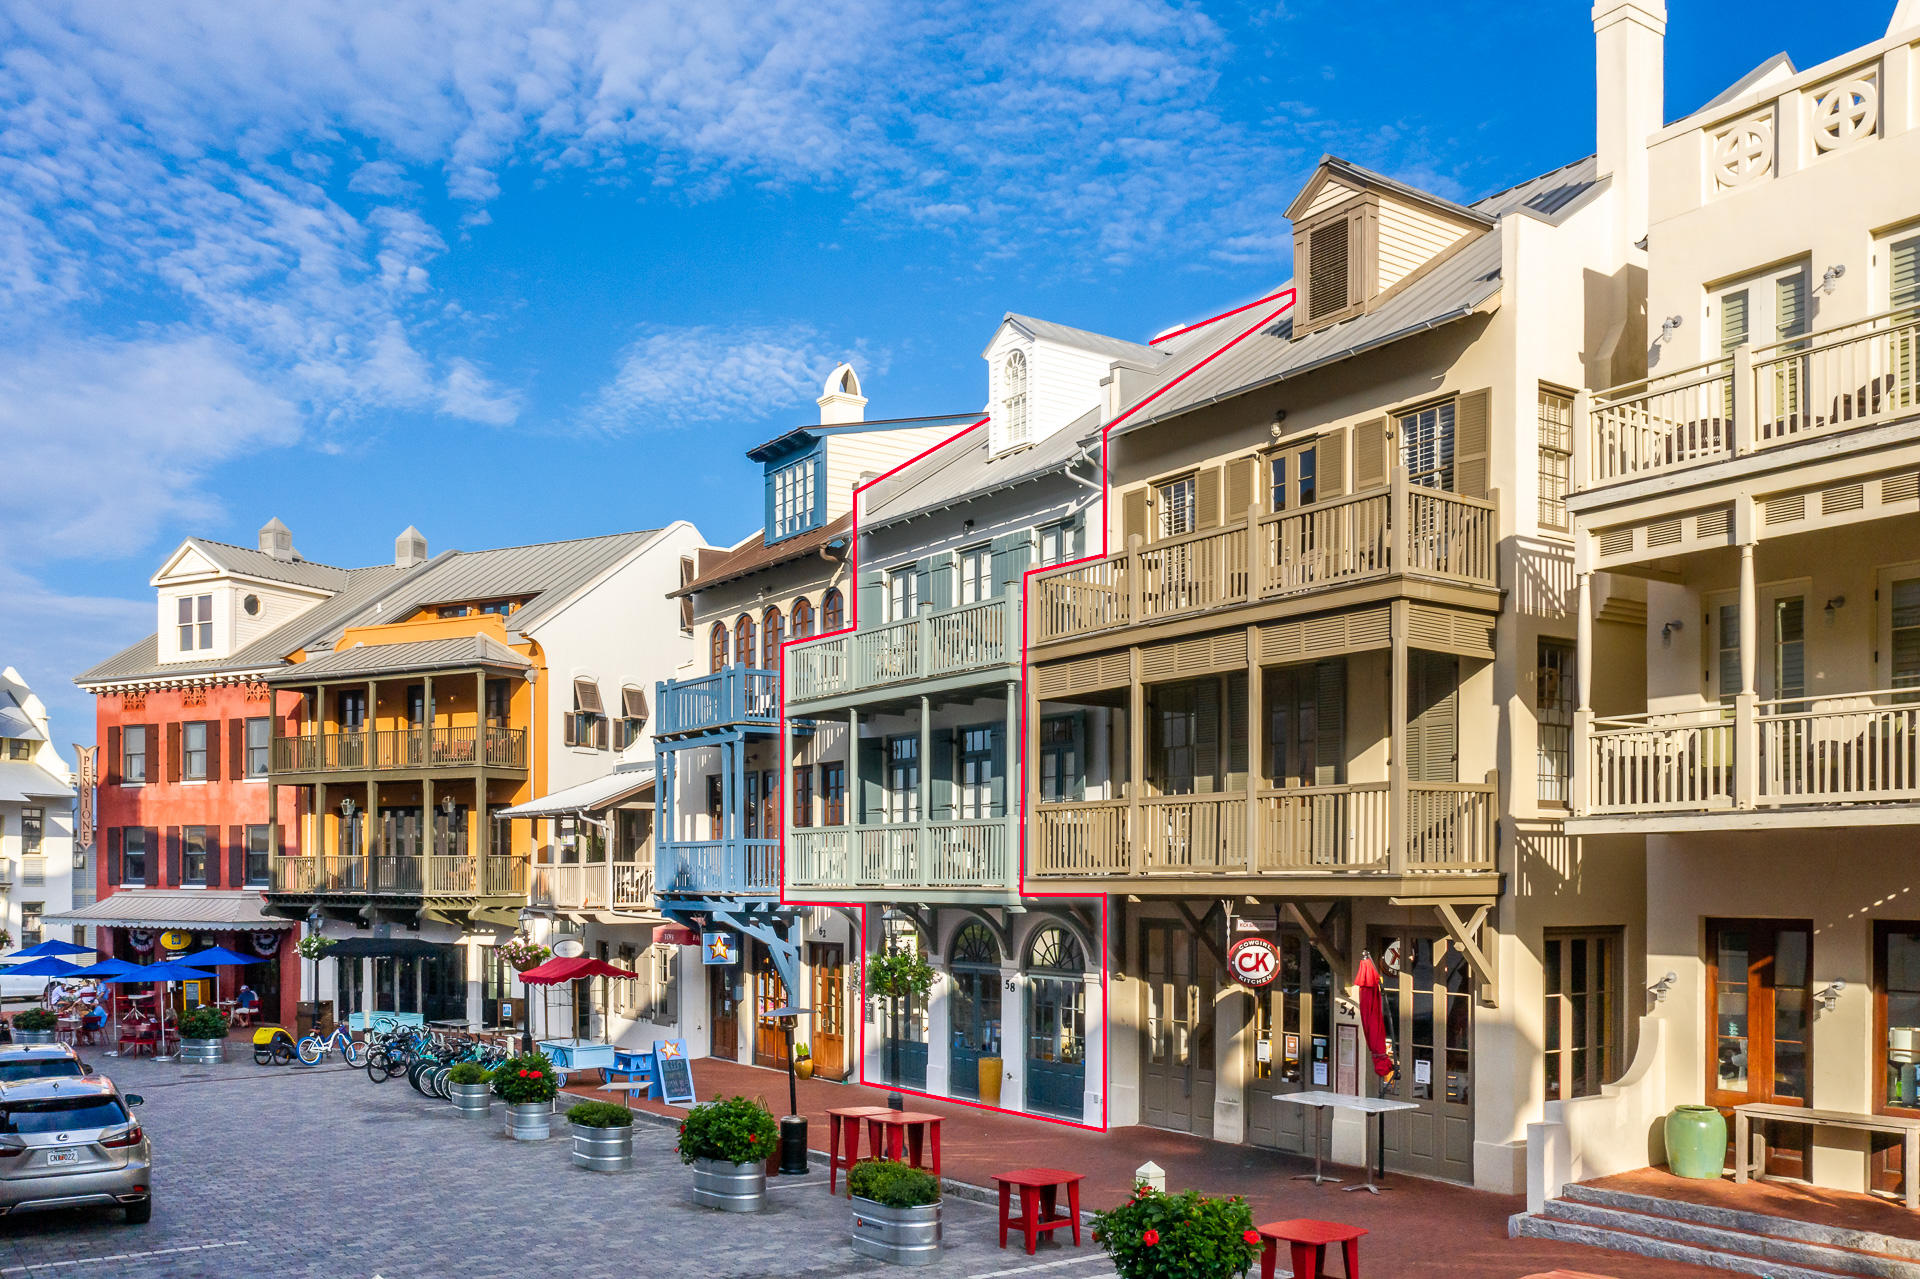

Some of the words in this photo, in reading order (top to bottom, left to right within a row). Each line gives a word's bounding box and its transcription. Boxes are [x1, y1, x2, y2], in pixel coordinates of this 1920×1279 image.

[82, 755, 91, 841] PENSIONE
[818, 926, 827, 938] 62
[1238, 939, 1272, 951] COWGIRL
[1238, 952, 1270, 972] CK
[1238, 974, 1273, 985] KITCHEN
[1005, 980, 1015, 992] 58
[1340, 1003, 1355, 1019] 54
